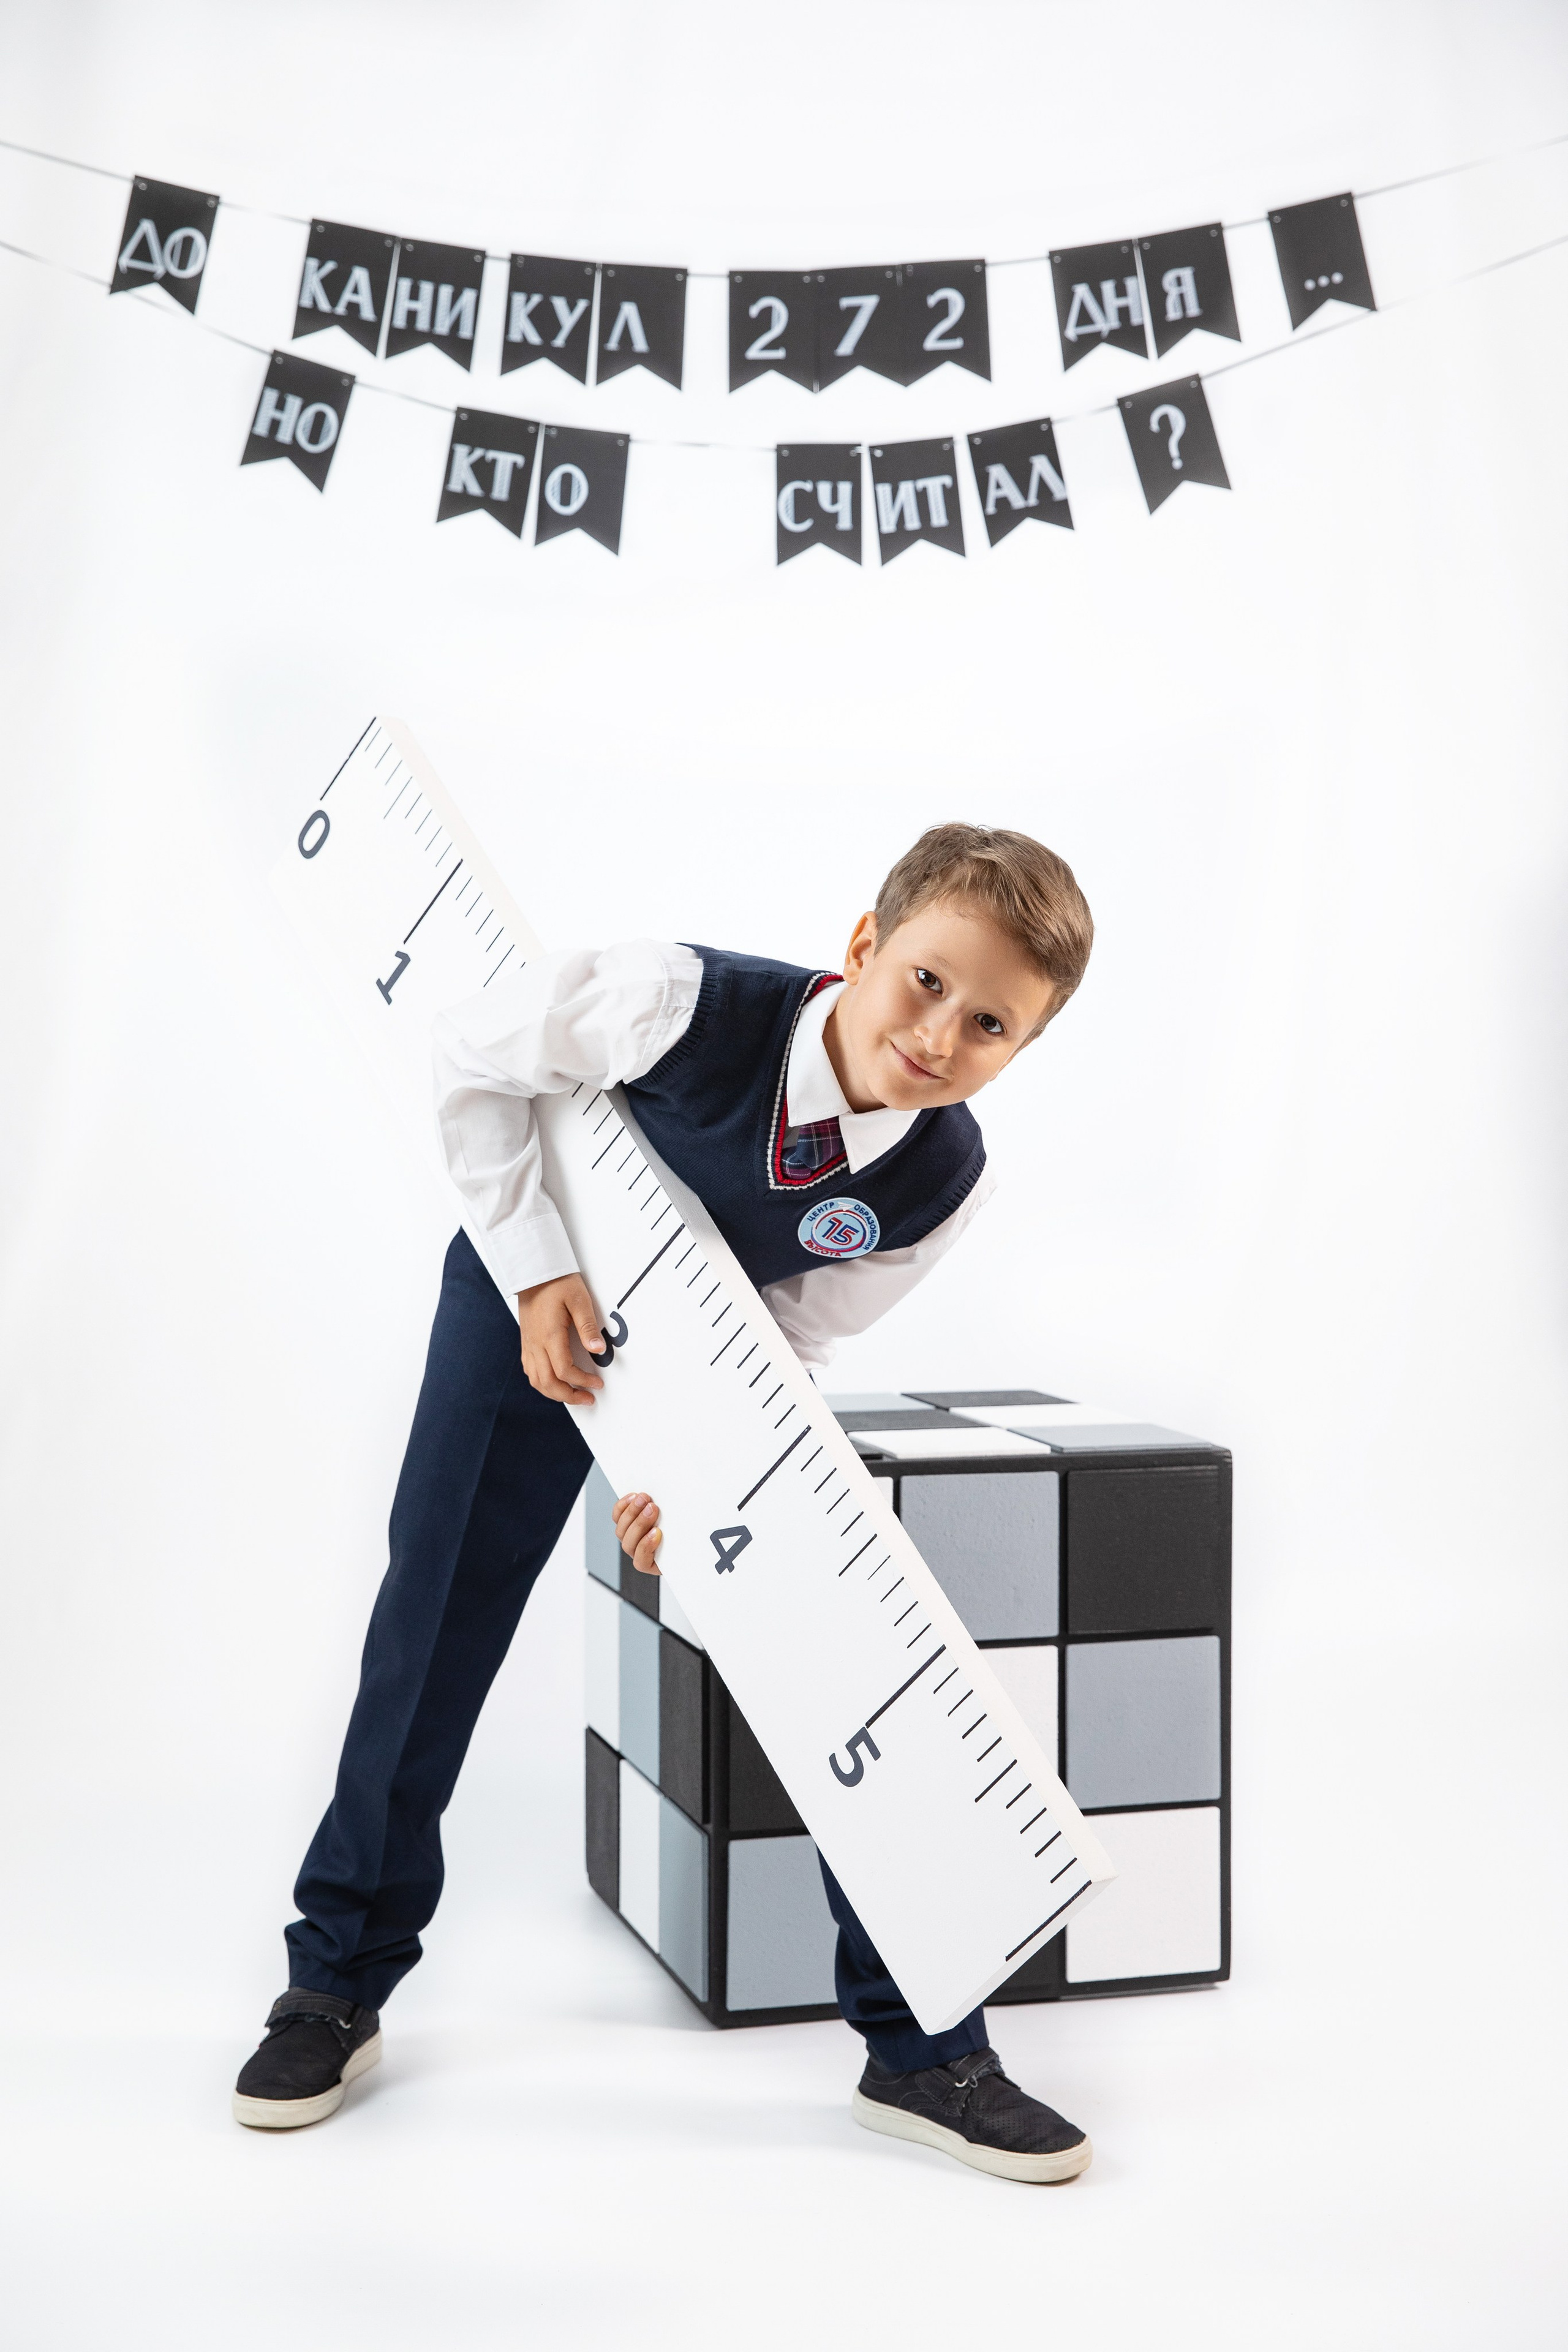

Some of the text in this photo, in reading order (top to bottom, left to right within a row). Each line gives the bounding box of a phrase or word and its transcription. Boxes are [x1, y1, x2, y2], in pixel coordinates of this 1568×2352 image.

[118, 218, 208, 280] ДО
[744, 287, 967, 360] 272
[1063, 266, 1202, 343] ДНЯ
[251, 386, 341, 453] НО
[446, 443, 589, 516] КТО
[1148, 403, 1187, 470] ?
[298, 809, 331, 859] 0
[375, 950, 412, 1006] 1
[804, 1239, 842, 1257] ВЫСОТА
[807, 1202, 877, 1251] ЦЕНТР ОБРАЗОВАНИЯ
[821, 1216, 860, 1246] 15
[589, 1311, 628, 1368] 3
[709, 1525, 753, 1575] 4
[829, 1726, 882, 1788] 5
